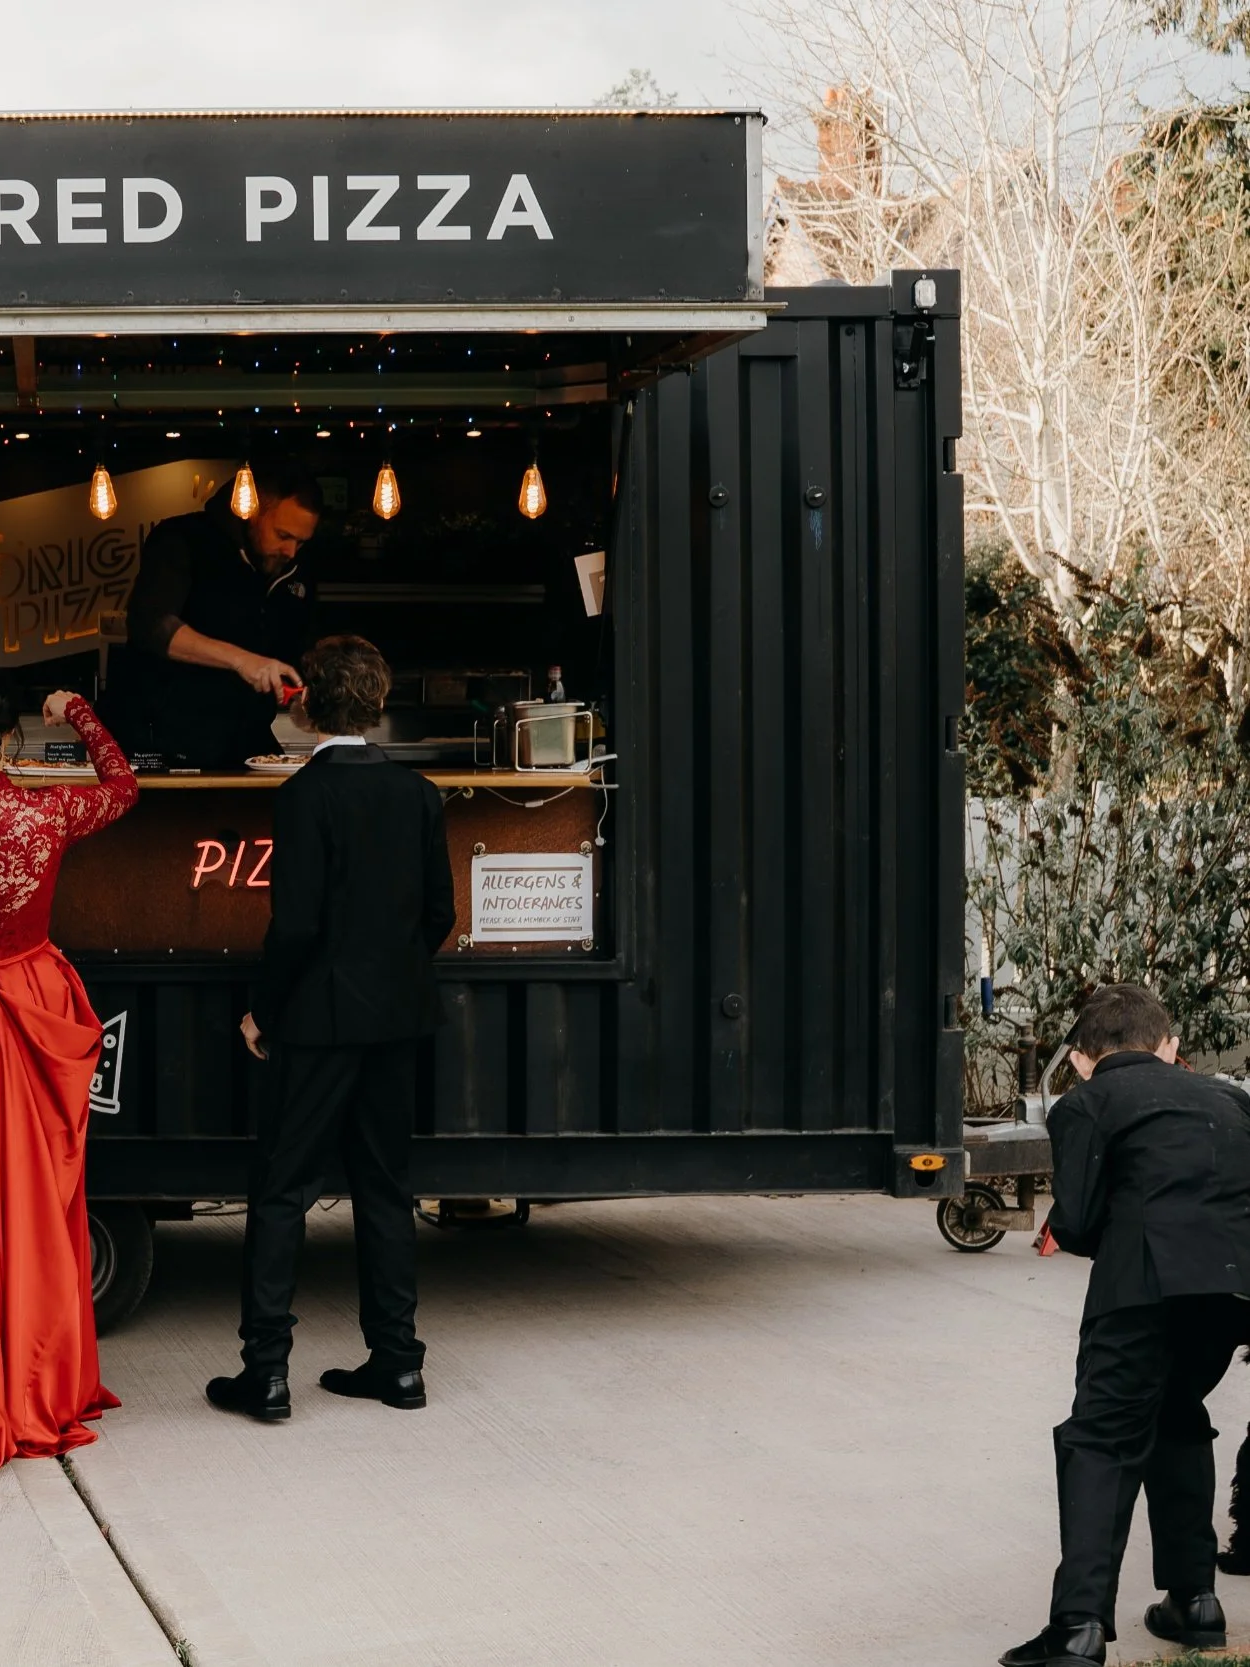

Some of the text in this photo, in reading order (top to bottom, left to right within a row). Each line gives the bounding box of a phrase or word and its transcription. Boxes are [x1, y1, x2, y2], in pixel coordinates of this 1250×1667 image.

[246, 173, 554, 242] PIZZA
[481, 873, 582, 891] ALLERGENS &
[482, 895, 583, 911] INTOLERANCES
[479, 916, 501, 924] PLEASE
[523, 916, 551, 924] MEMBER
[563, 915, 582, 923] STAFF
